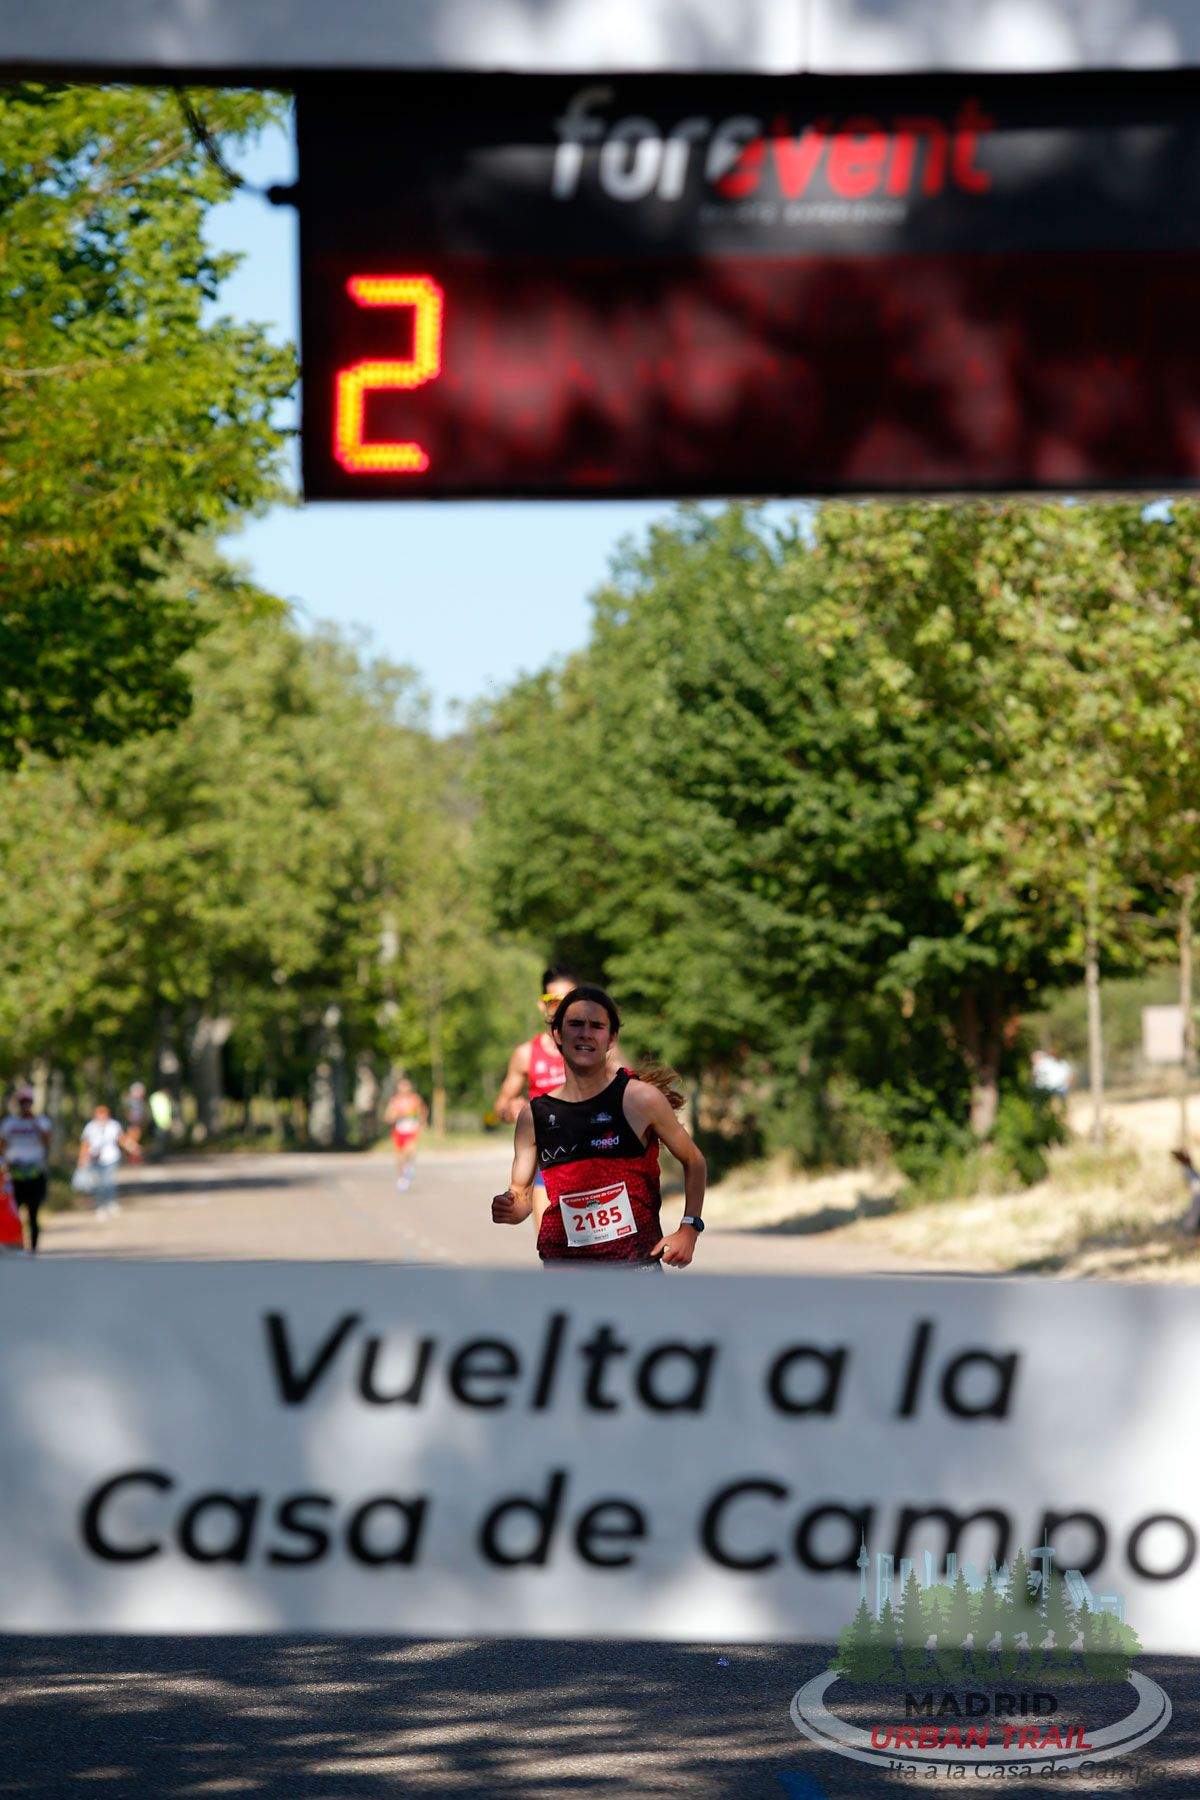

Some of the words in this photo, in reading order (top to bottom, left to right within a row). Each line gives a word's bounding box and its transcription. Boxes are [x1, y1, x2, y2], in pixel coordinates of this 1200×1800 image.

[550, 82, 997, 200] forevent
[333, 274, 445, 473] 2
[591, 1136, 619, 1147] speed
[572, 1205, 622, 1232] 2185
[262, 1310, 720, 1416] Vuelta
[764, 1344, 850, 1418] a
[897, 1319, 1020, 1421] la
[79, 1467, 430, 1570] Casa
[475, 1468, 649, 1570] de
[697, 1475, 1197, 1604] Campo
